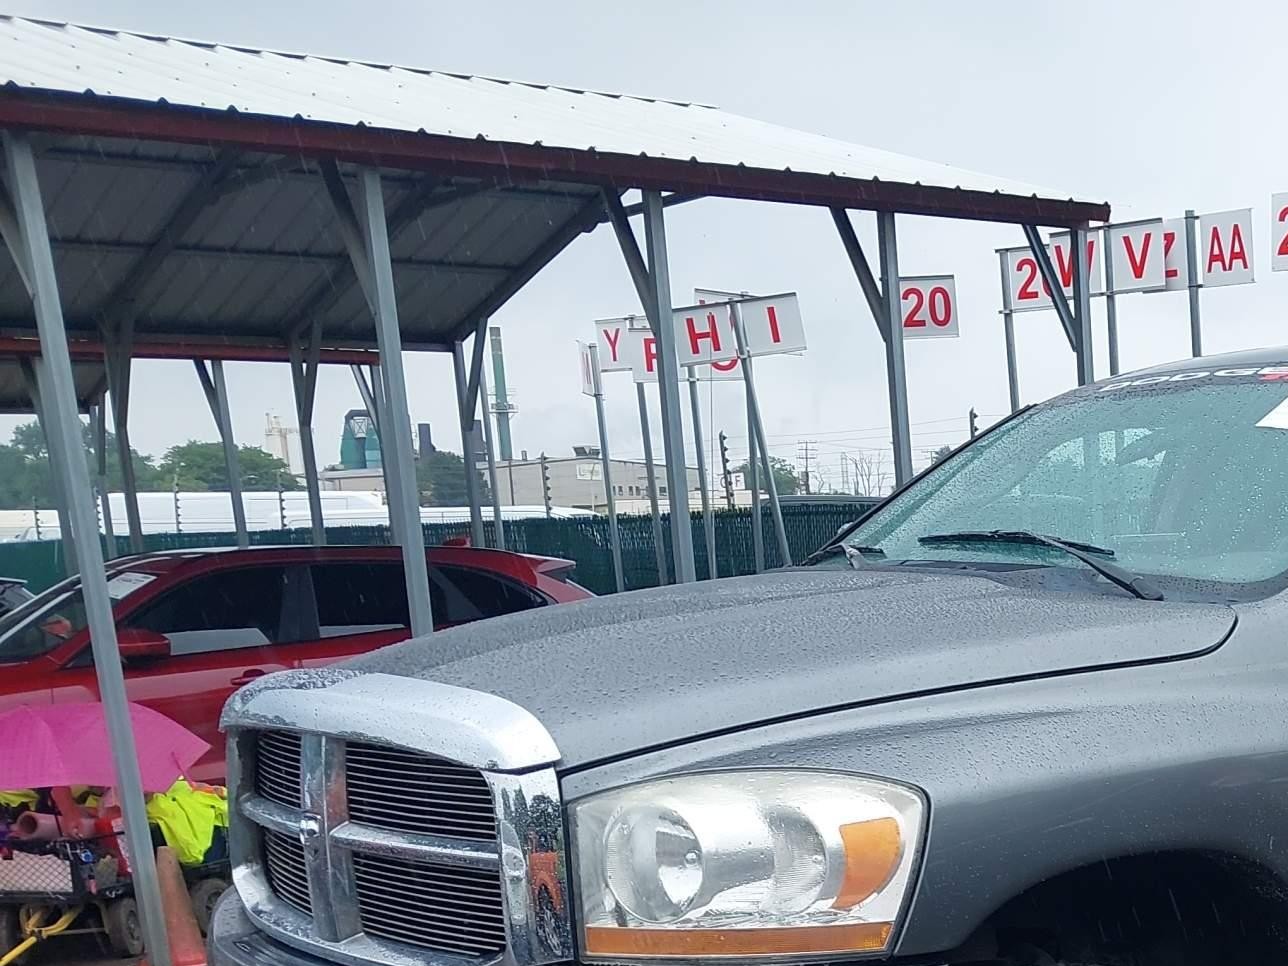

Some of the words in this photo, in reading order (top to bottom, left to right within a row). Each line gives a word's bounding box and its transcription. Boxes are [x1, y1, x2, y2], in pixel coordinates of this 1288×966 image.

[1054, 240, 1095, 289] W
[1122, 232, 1152, 279] V
[1206, 223, 1249, 274] AA
[766, 306, 781, 344] I
[902, 286, 952, 328] 20
[602, 327, 620, 362] Y
[686, 312, 722, 355] H
